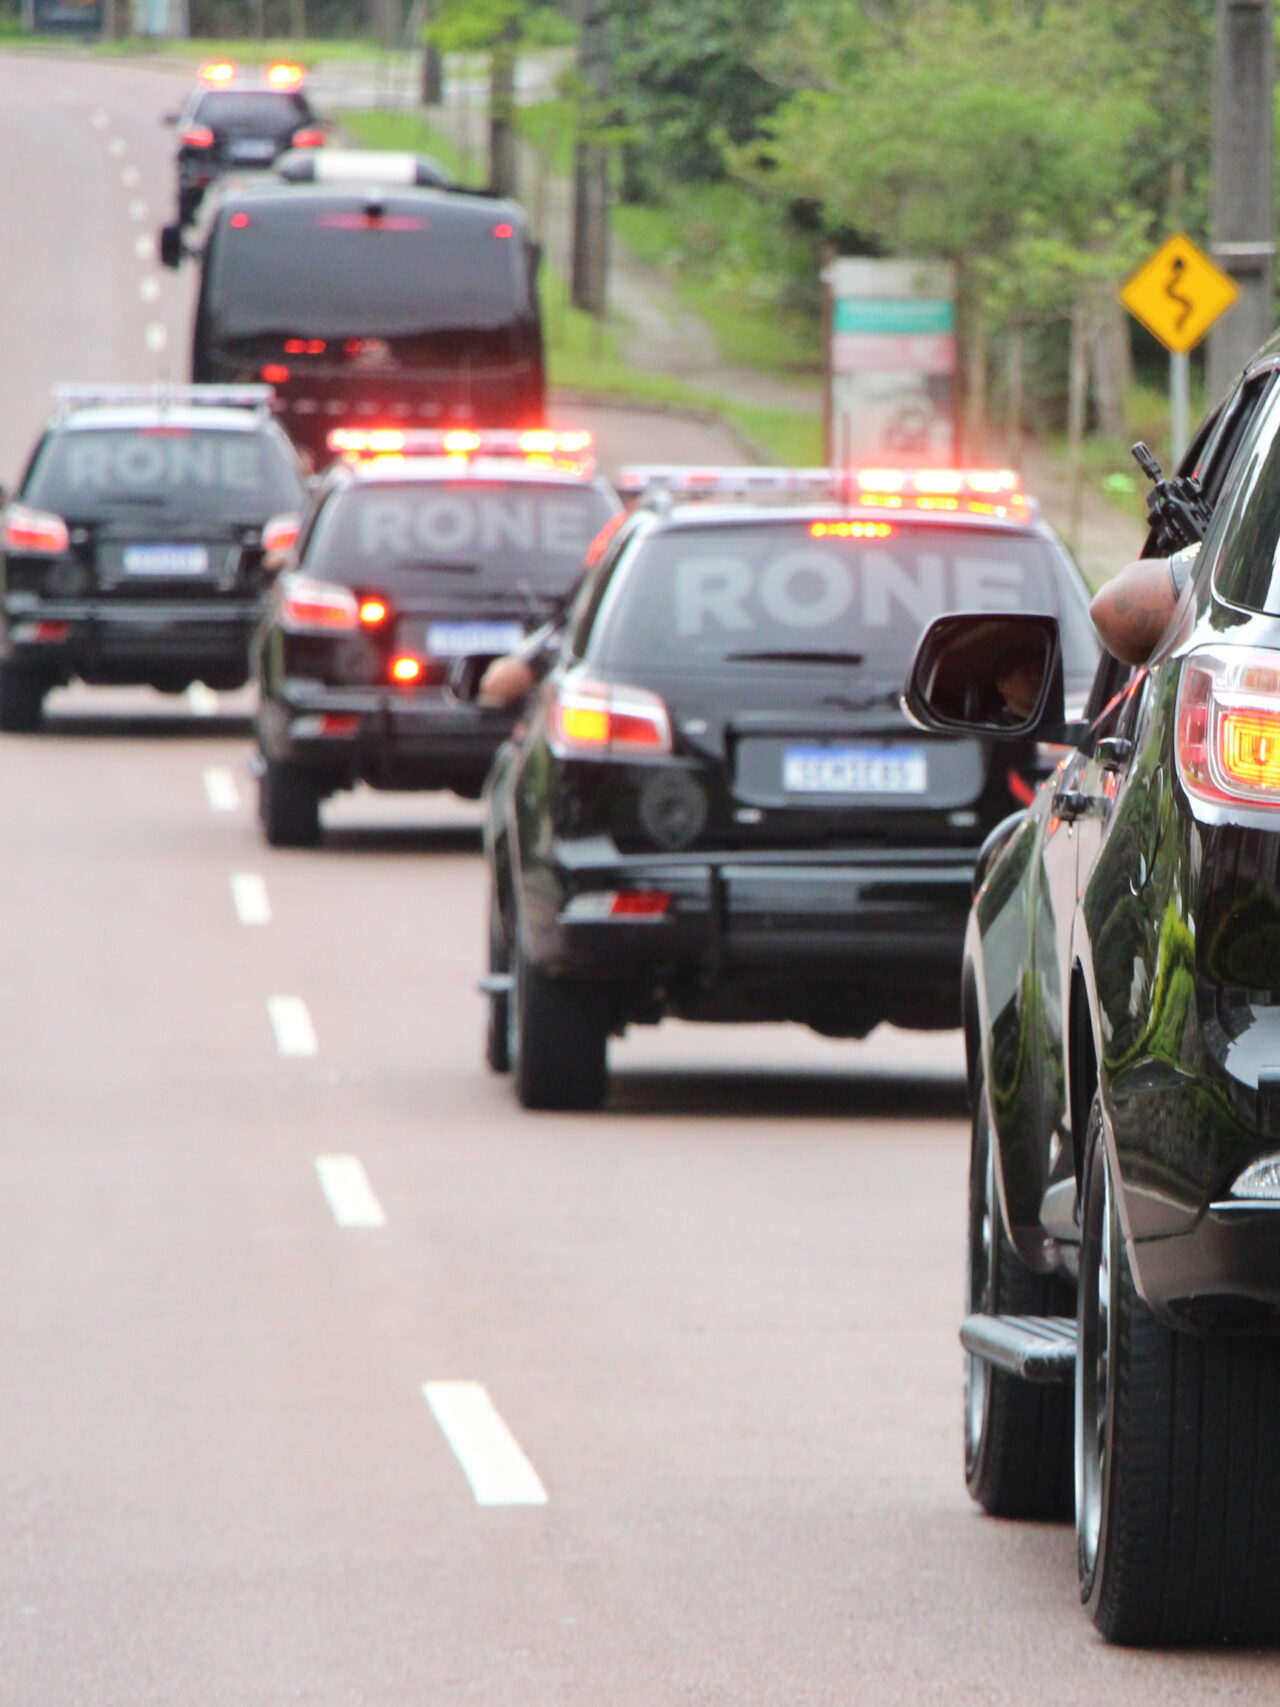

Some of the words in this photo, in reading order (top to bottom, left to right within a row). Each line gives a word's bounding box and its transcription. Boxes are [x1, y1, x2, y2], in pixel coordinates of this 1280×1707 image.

[68, 440, 259, 489] RONE
[358, 501, 587, 553] RONE
[674, 551, 1023, 636] RONE
